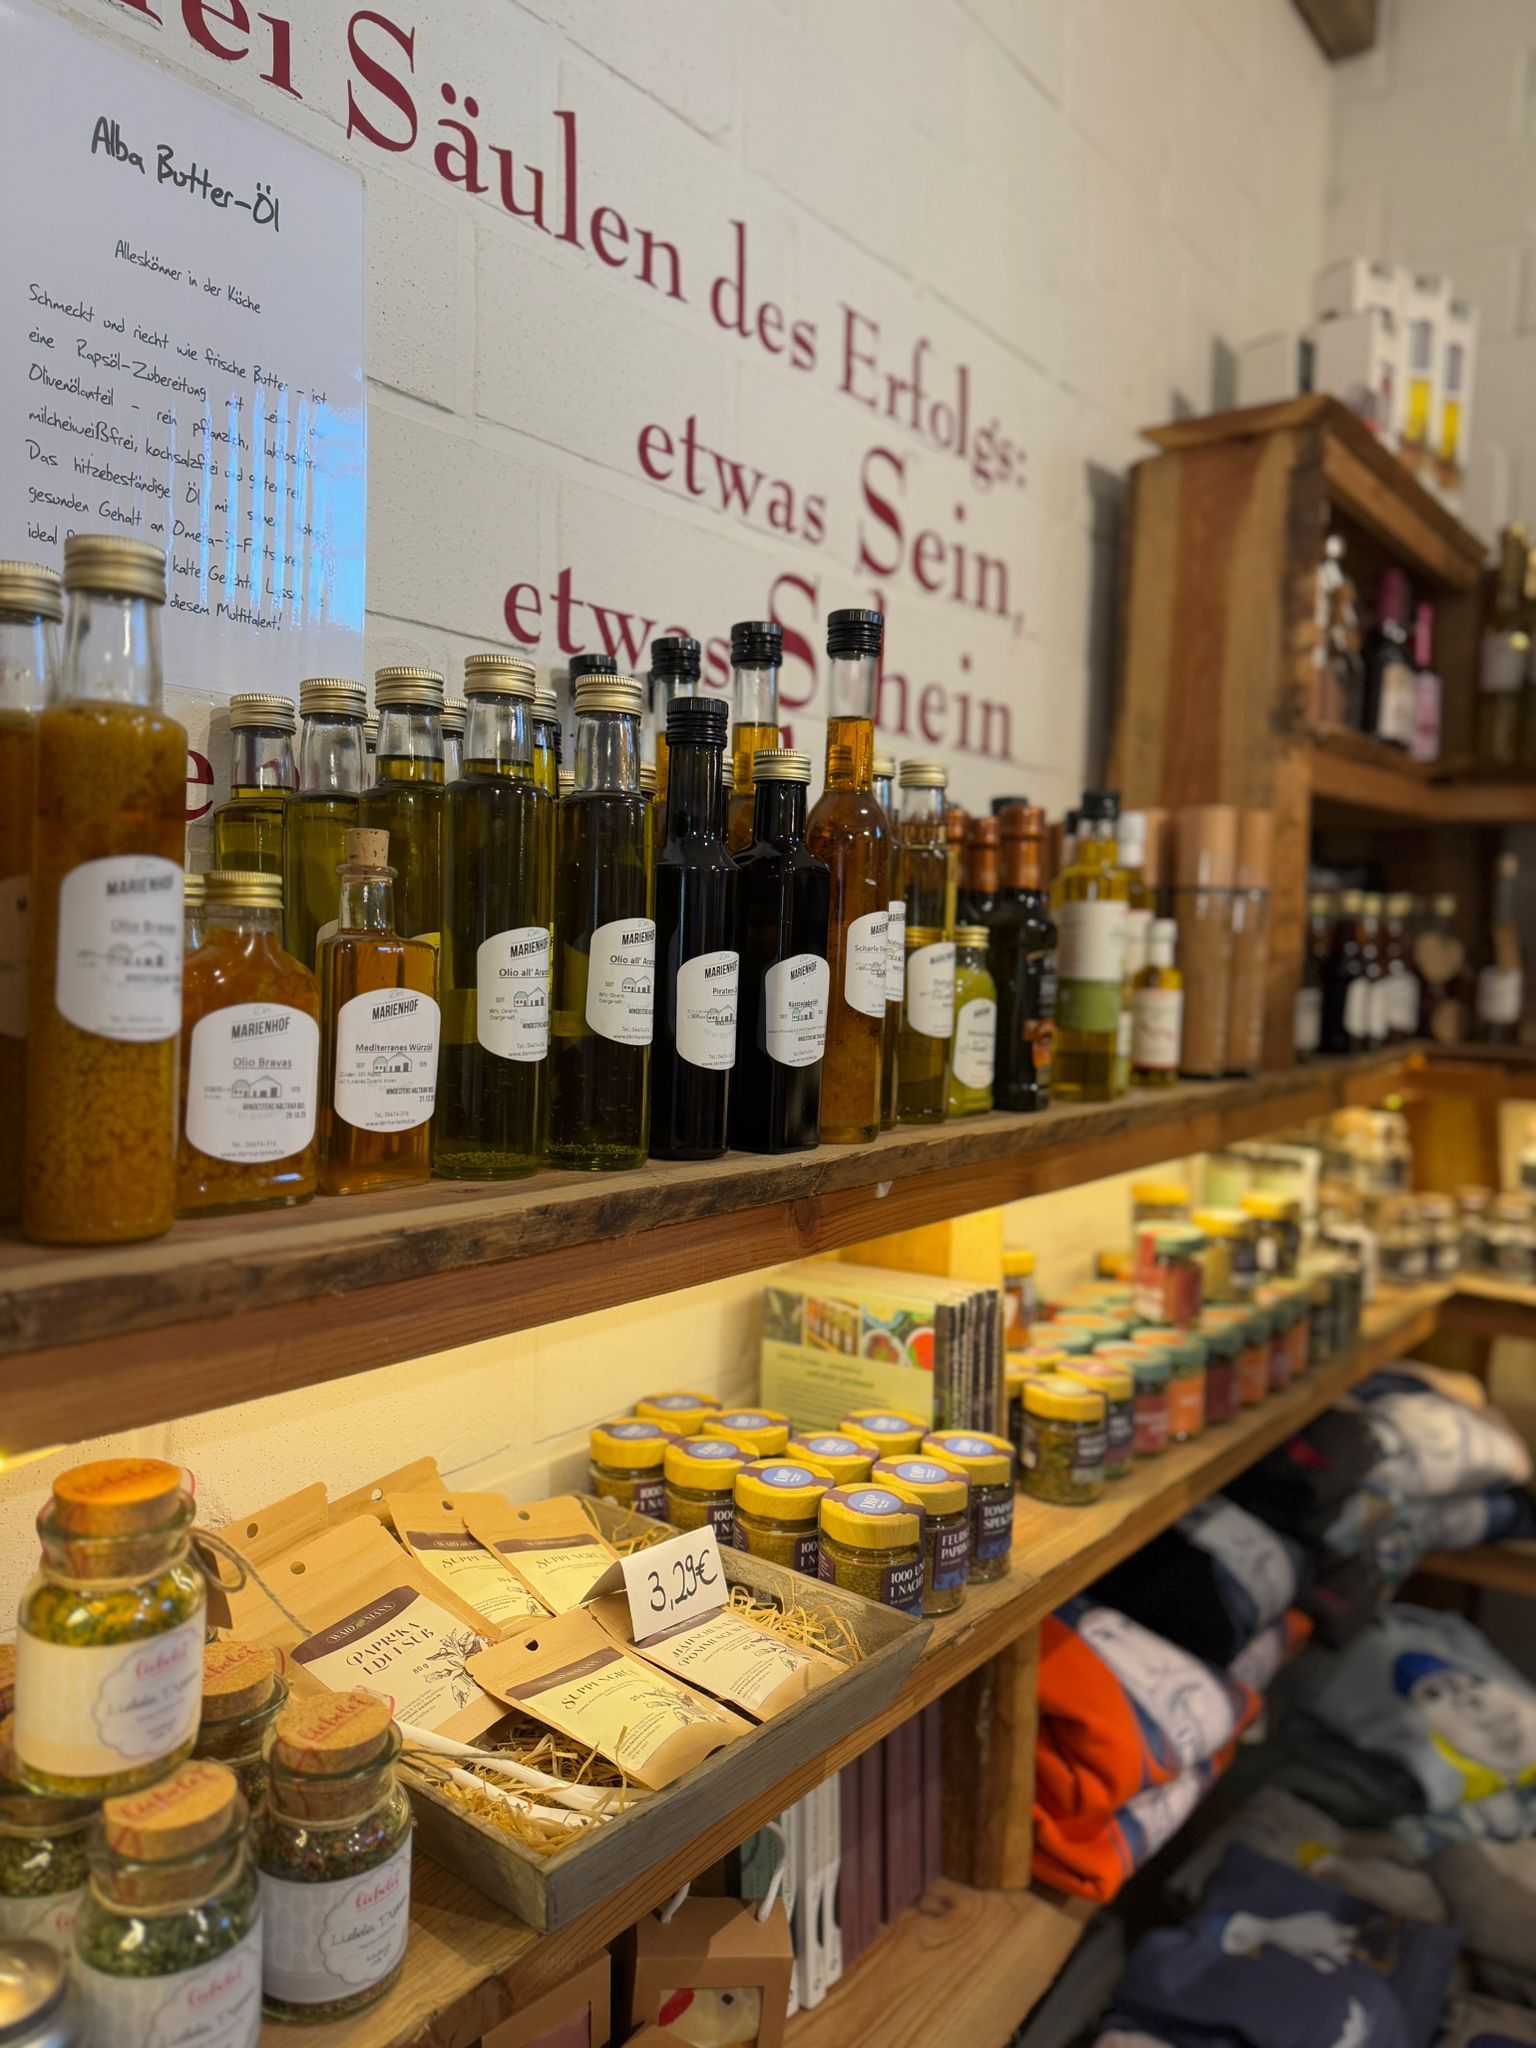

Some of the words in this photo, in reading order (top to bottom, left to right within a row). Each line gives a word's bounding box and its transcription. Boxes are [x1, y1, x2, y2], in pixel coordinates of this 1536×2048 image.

[91, 116, 146, 174] Alba
[156, 144, 280, 232] Butter-Öl
[346, 10, 688, 304] Säulen
[709, 221, 818, 373] des
[838, 301, 1028, 495] Erfolgs:
[115, 240, 182, 281] Alleskönner
[188, 270, 198, 287] in
[203, 277, 222, 298] der
[227, 284, 262, 314] Küche
[29, 283, 95, 323] Schmeckt
[103, 317, 125, 334] und
[134, 325, 169, 350] riecht
[176, 343, 199, 361] wie
[205, 348, 247, 380] frische
[312, 388, 327, 405] ist
[29, 326, 55, 348] eine
[76, 338, 208, 402] Rapsöl-Zubereitung
[29, 363, 113, 406] Olivenölanteil
[156, 411, 178, 426] rein
[28, 407, 139, 453] milcheiweißfrei,
[26, 438, 59, 467] Das
[74, 453, 172, 500] hitzebeständige
[186, 481, 201, 506] Öl
[29, 486, 89, 512] gesunden
[98, 501, 142, 526] Gehalt
[150, 523, 164, 532] an
[637, 415, 827, 545] etwas
[856, 446, 1024, 636] Sein,
[28, 521, 58, 545] ideal
[172, 555, 202, 578] kalte
[169, 593, 210, 616] diesem
[216, 602, 283, 631] Multitalent!
[768, 573, 1015, 760] Shein
[499, 967, 519, 977] Olio
[609, 954, 628, 964] Olio
[704, 959, 738, 979] MARIENHOF
[790, 961, 817, 980] MARIENHOF
[231, 1016, 291, 1040] MARIENHOF
[372, 999, 420, 1021] MARIENHOF
[232, 1057, 256, 1068] Olio
[259, 1057, 293, 1068] Bravas
[355, 1043, 407, 1052] Mediterranes
[408, 1043, 433, 1052] Würzöl
[647, 1549, 718, 1612] 3,29€
[890, 1569, 913, 1584] 1000
[330, 1625, 356, 1641] WAID
[364, 1603, 393, 1621] MANN
[346, 1621, 421, 1666] PAPRIKA
